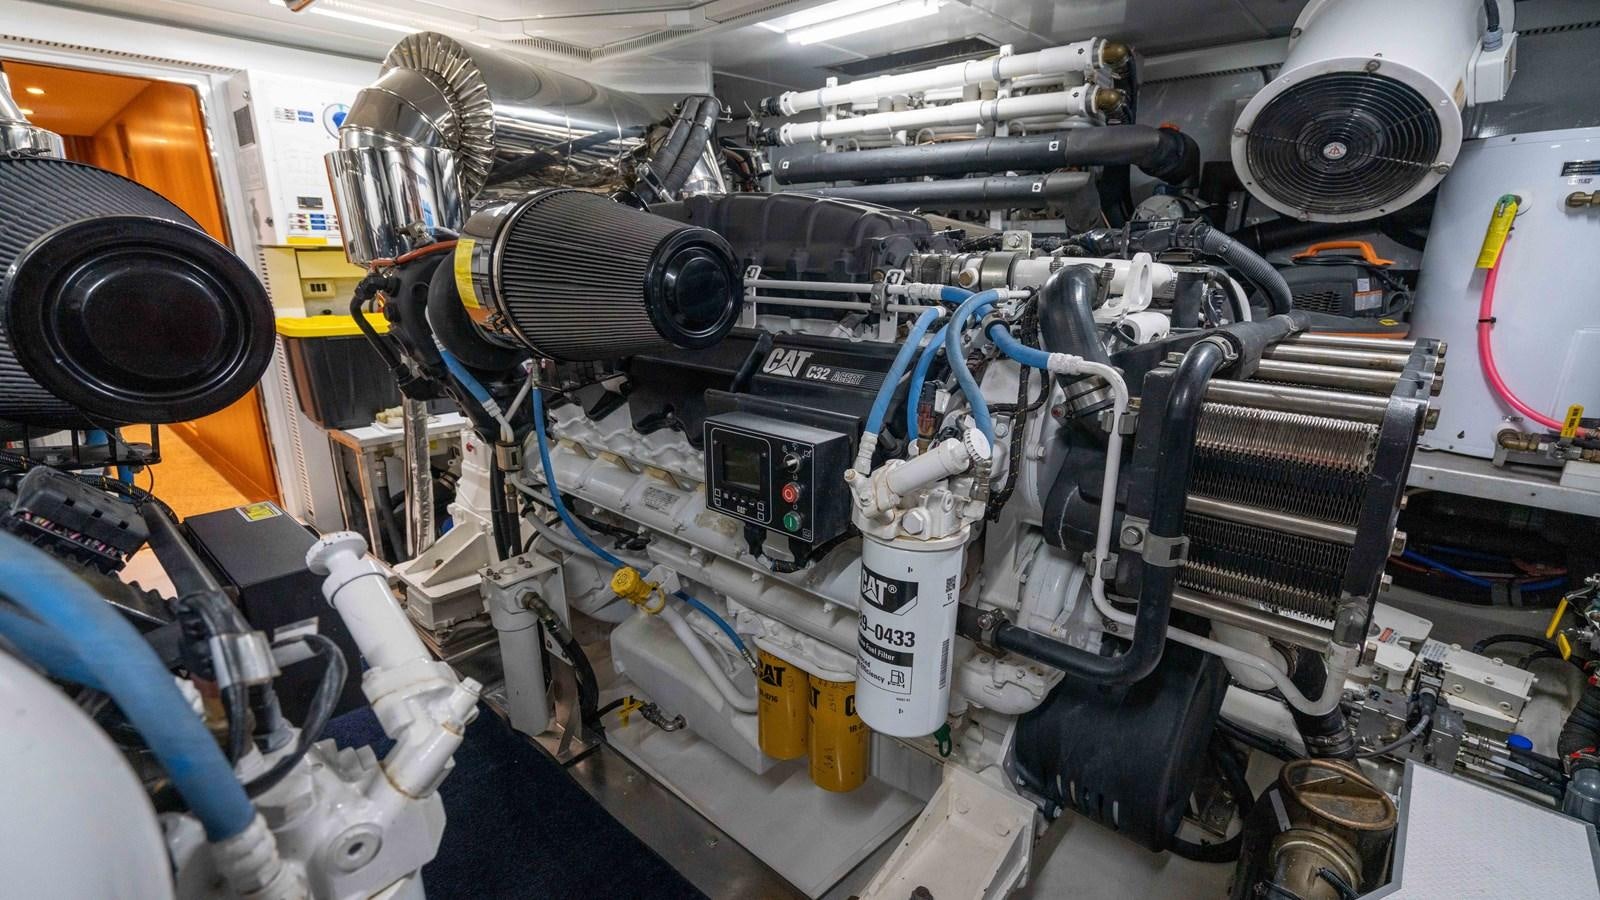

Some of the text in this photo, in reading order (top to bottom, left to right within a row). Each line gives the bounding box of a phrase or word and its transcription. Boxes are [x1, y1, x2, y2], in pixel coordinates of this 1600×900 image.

[763, 348, 814, 378] CAT
[806, 365, 831, 380] C32
[878, 650, 896, 661] Filter
